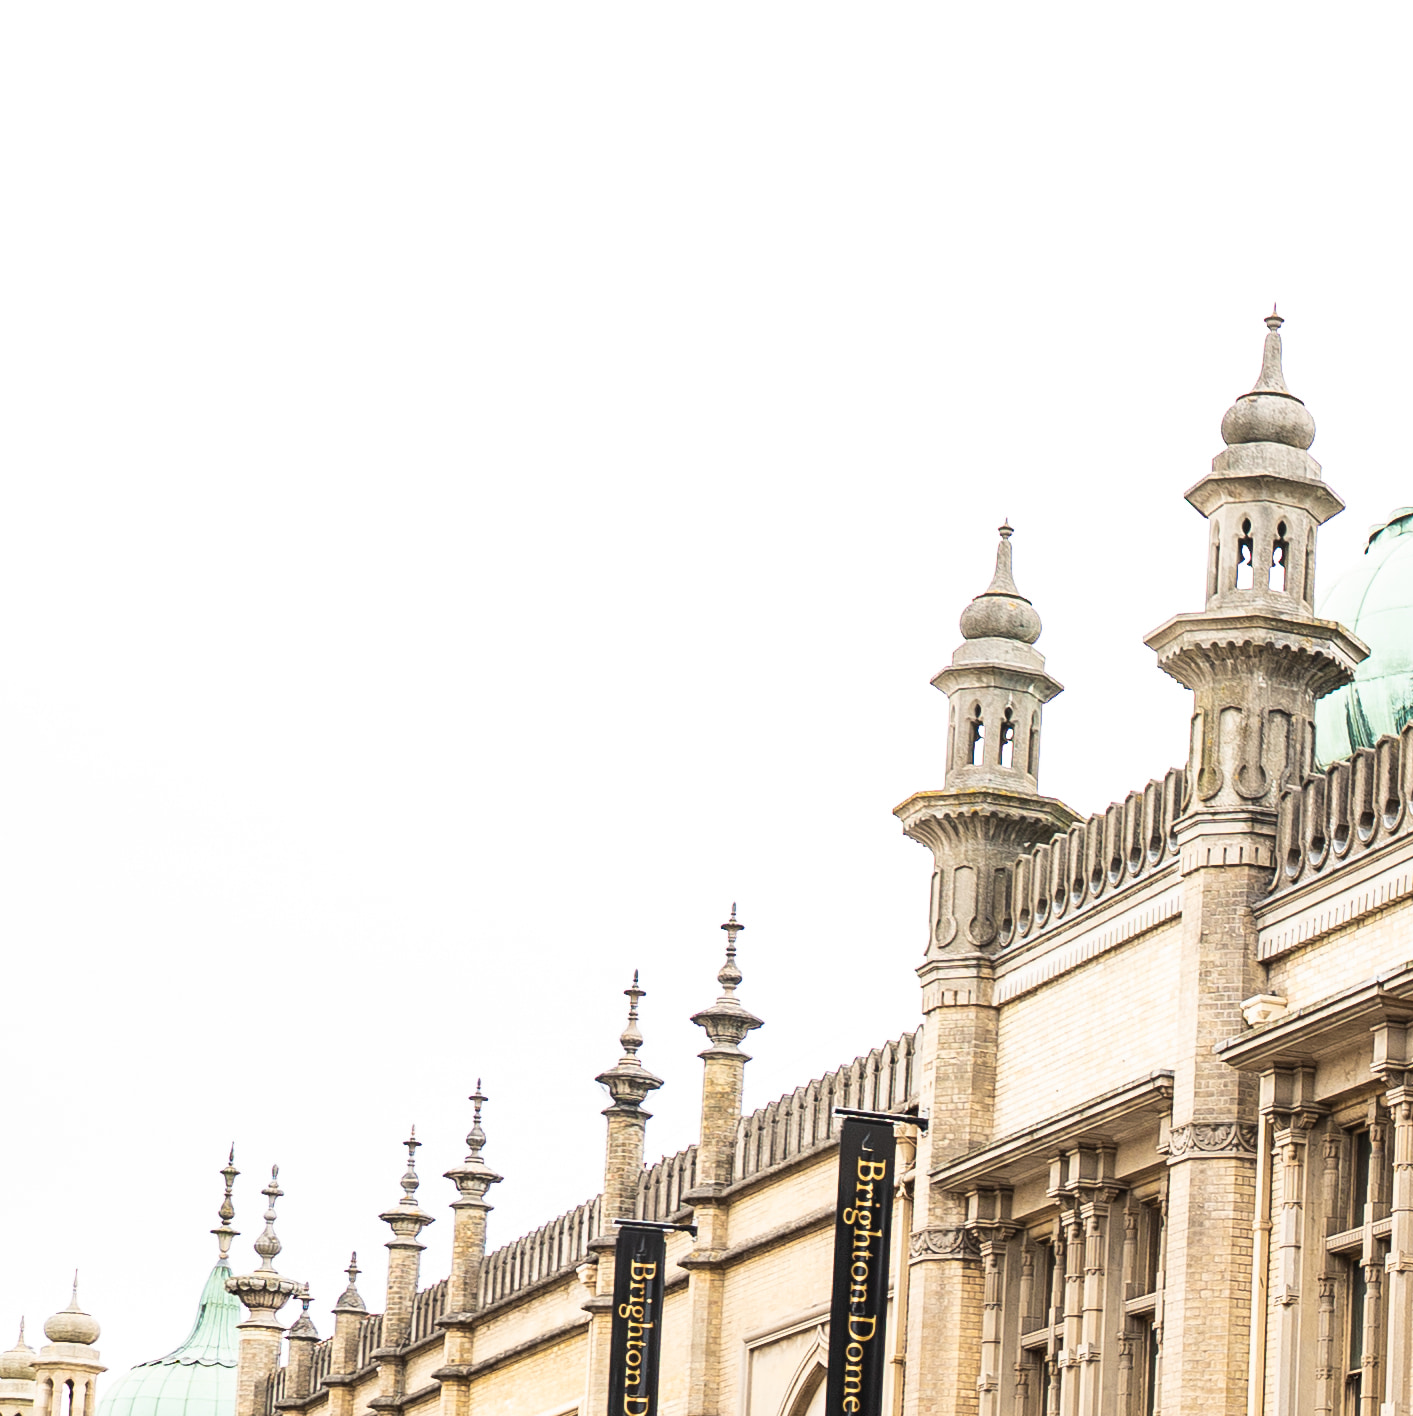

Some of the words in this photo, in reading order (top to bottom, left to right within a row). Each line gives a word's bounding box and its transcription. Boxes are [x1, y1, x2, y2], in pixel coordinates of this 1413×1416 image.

[842, 1156, 887, 1304] Brighton
[618, 1259, 657, 1388] Brighton
[842, 1312, 877, 1414] Dome
